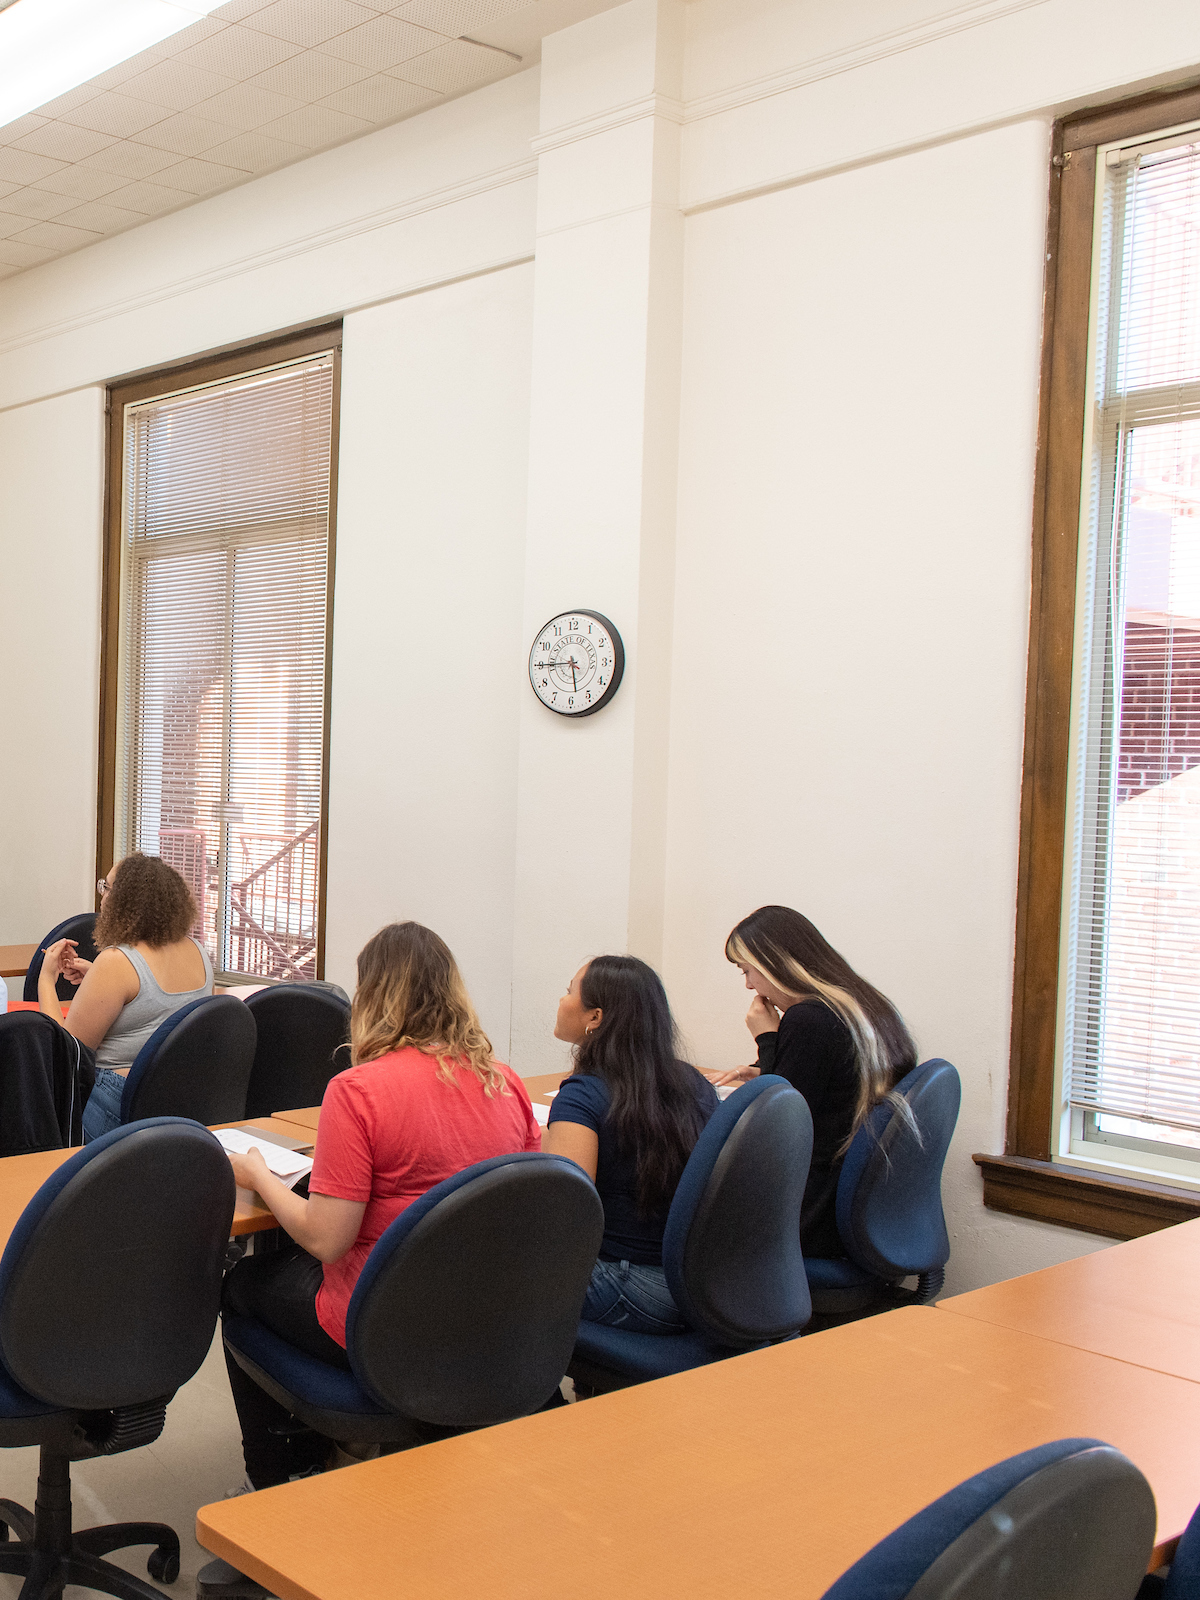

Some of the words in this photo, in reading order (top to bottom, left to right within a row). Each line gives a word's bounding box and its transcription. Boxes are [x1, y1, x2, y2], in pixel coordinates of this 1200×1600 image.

[568, 622, 578, 630] 12
[588, 625, 592, 634] 1
[555, 627, 562, 636] 11
[542, 642, 550, 651] 10
[599, 638, 604, 647] 2
[554, 636, 573, 651] STATE
[586, 643, 596, 669] TEXAS
[538, 661, 544, 670] 9
[602, 658, 607, 666] 3
[542, 678, 548, 687] 8
[598, 676, 603, 685] 4
[552, 692, 558, 701] 7
[586, 690, 591, 699] 5
[568, 696, 574, 705] 6
